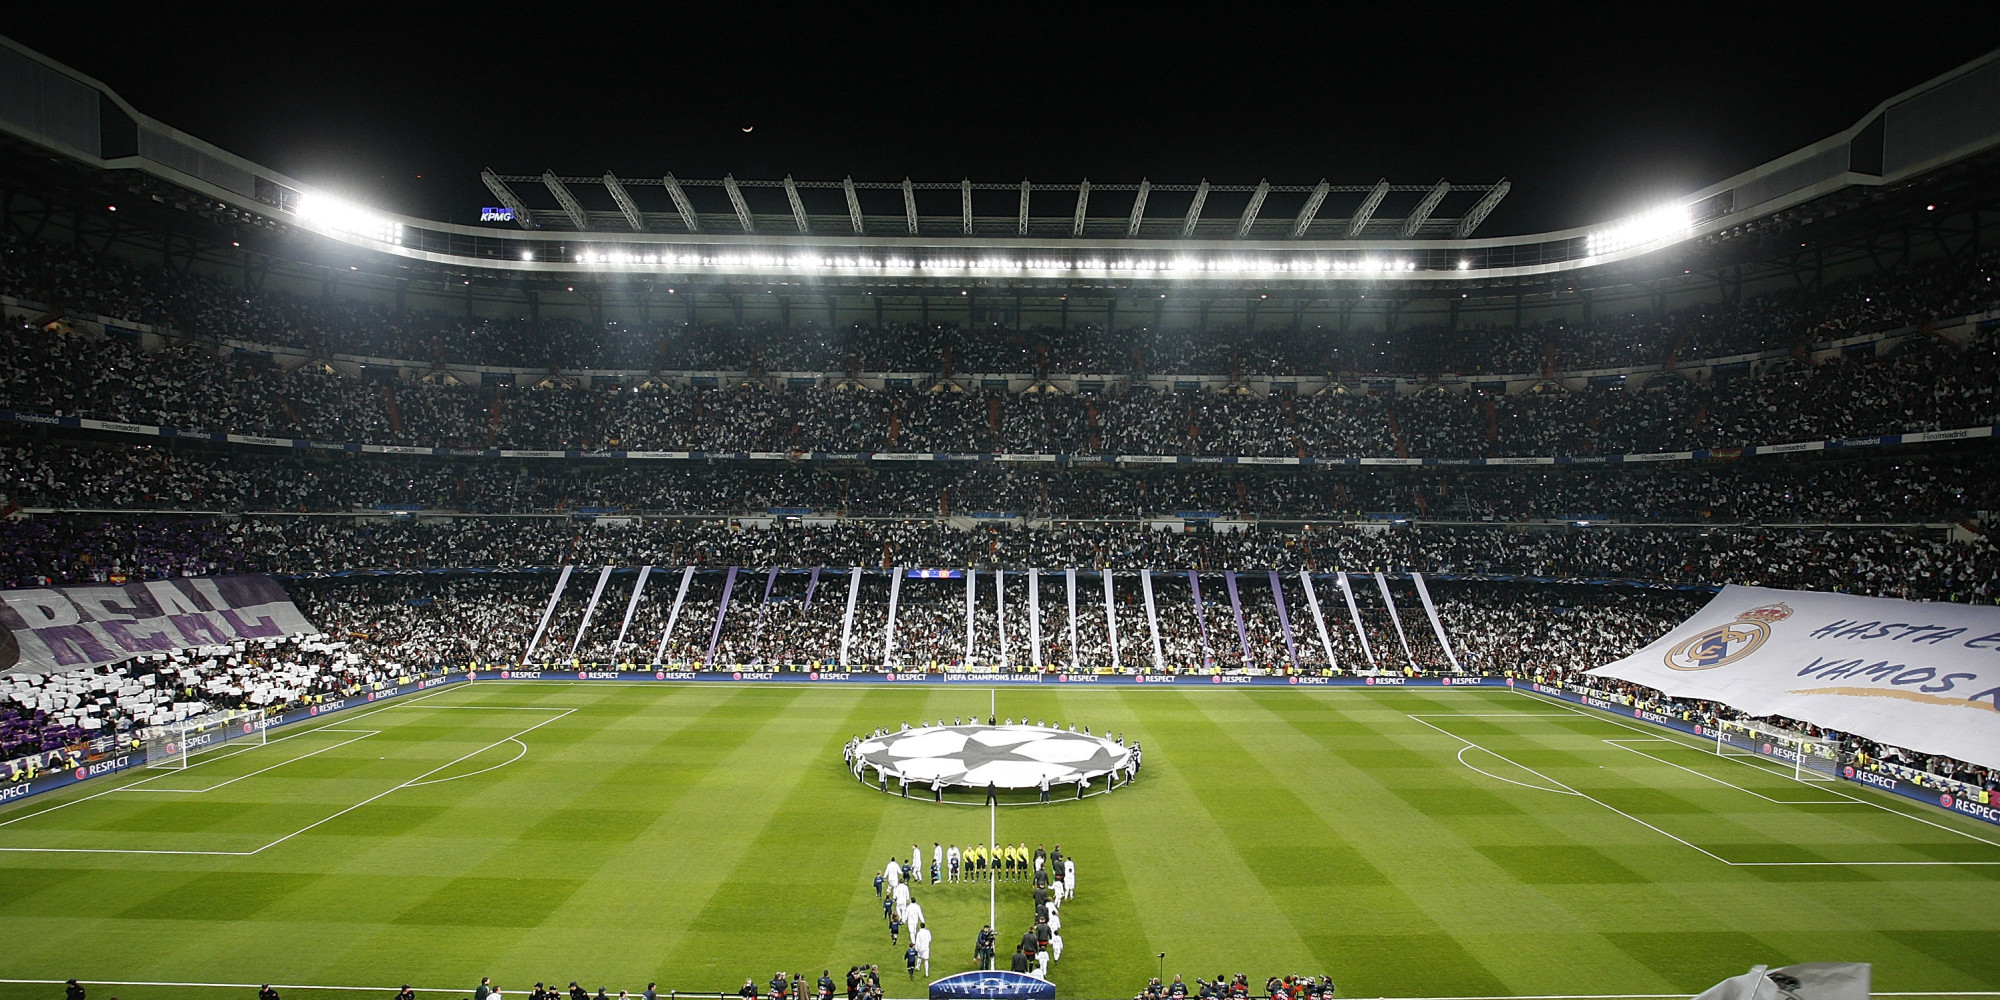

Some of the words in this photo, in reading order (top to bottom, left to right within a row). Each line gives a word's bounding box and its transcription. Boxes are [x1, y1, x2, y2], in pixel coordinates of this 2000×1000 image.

[480, 213, 512, 222] KPMG
[102, 422, 140, 433] Realmadrid
[1922, 430, 1967, 441] Realmadrid
[243, 437, 276, 445] Realmadrid
[310, 441, 344, 450] Realmadrid
[1842, 437, 1881, 447] Realmadrid
[1772, 444, 1806, 453] Realmadrid
[1437, 458, 1469, 466] Realmadrid
[1571, 456, 1606, 464] Realmadrid
[1641, 453, 1675, 461] Realmadrid
[1809, 619, 1968, 645] HASTA
[665, 672, 696, 680] RESPECT
[967, 674, 1009, 682] CHAMPIONS
[1145, 675, 1176, 683] RESPECT
[1796, 656, 1978, 693] VAMOS
[425, 676, 447, 688] RESPECT
[1375, 677, 1406, 685] RESPECT
[1451, 677, 1482, 685] RESPECT
[375, 687, 398, 699] RESPECT
[1539, 685, 1562, 696] RESPECT
[319, 700, 345, 713] RESPECT
[1588, 697, 1612, 710] RESPECT
[254, 715, 284, 730] RESPECT
[1642, 711, 1668, 724] RESPECT
[90, 756, 129, 775] RESPECT
[1856, 769, 1898, 790] RESPECT
